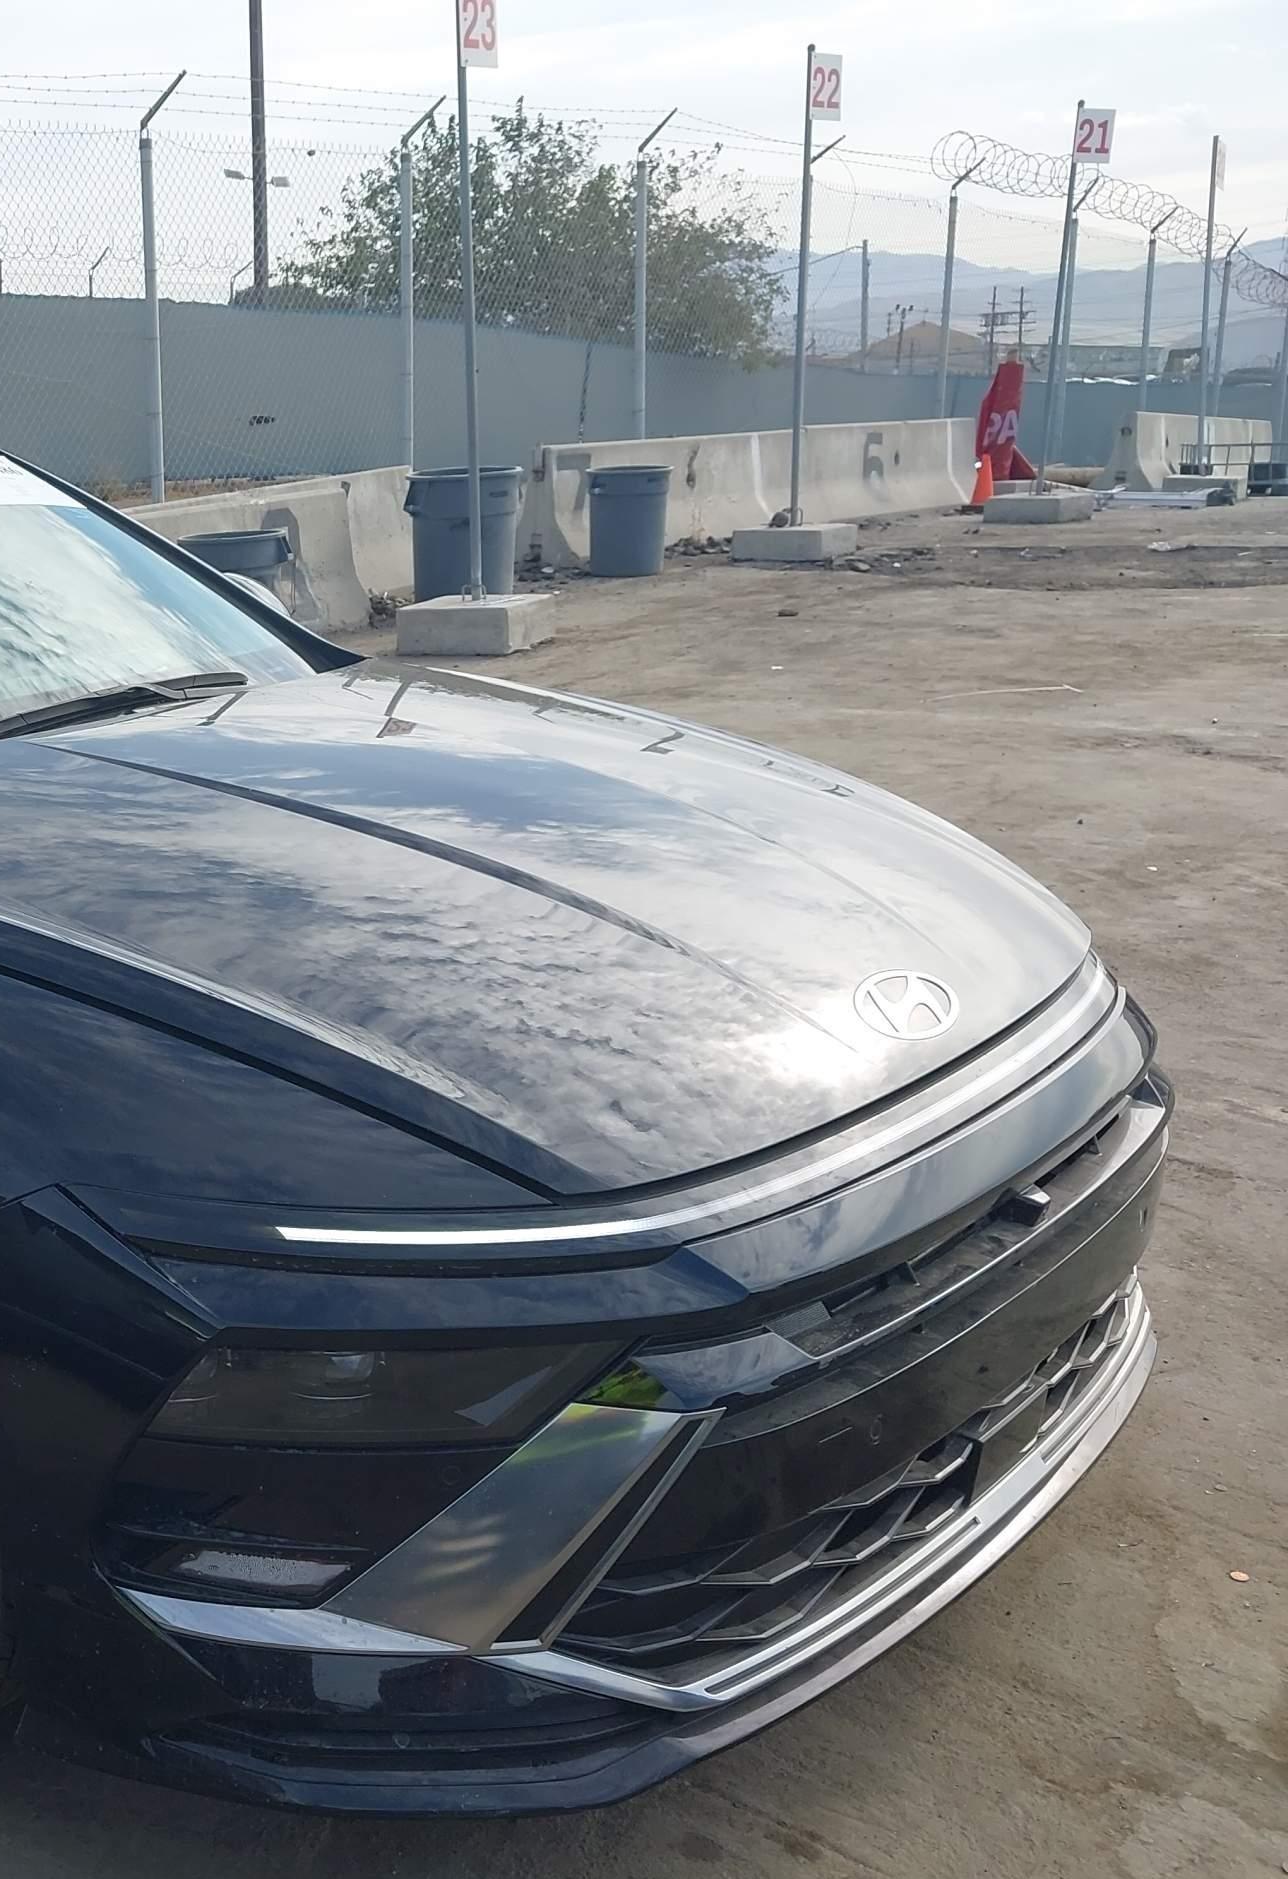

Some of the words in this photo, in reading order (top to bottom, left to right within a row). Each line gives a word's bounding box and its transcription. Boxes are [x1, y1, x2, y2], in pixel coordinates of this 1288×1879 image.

[463, 0, 496, 51] 23
[812, 66, 841, 109] 22
[1076, 118, 1110, 154] 21
